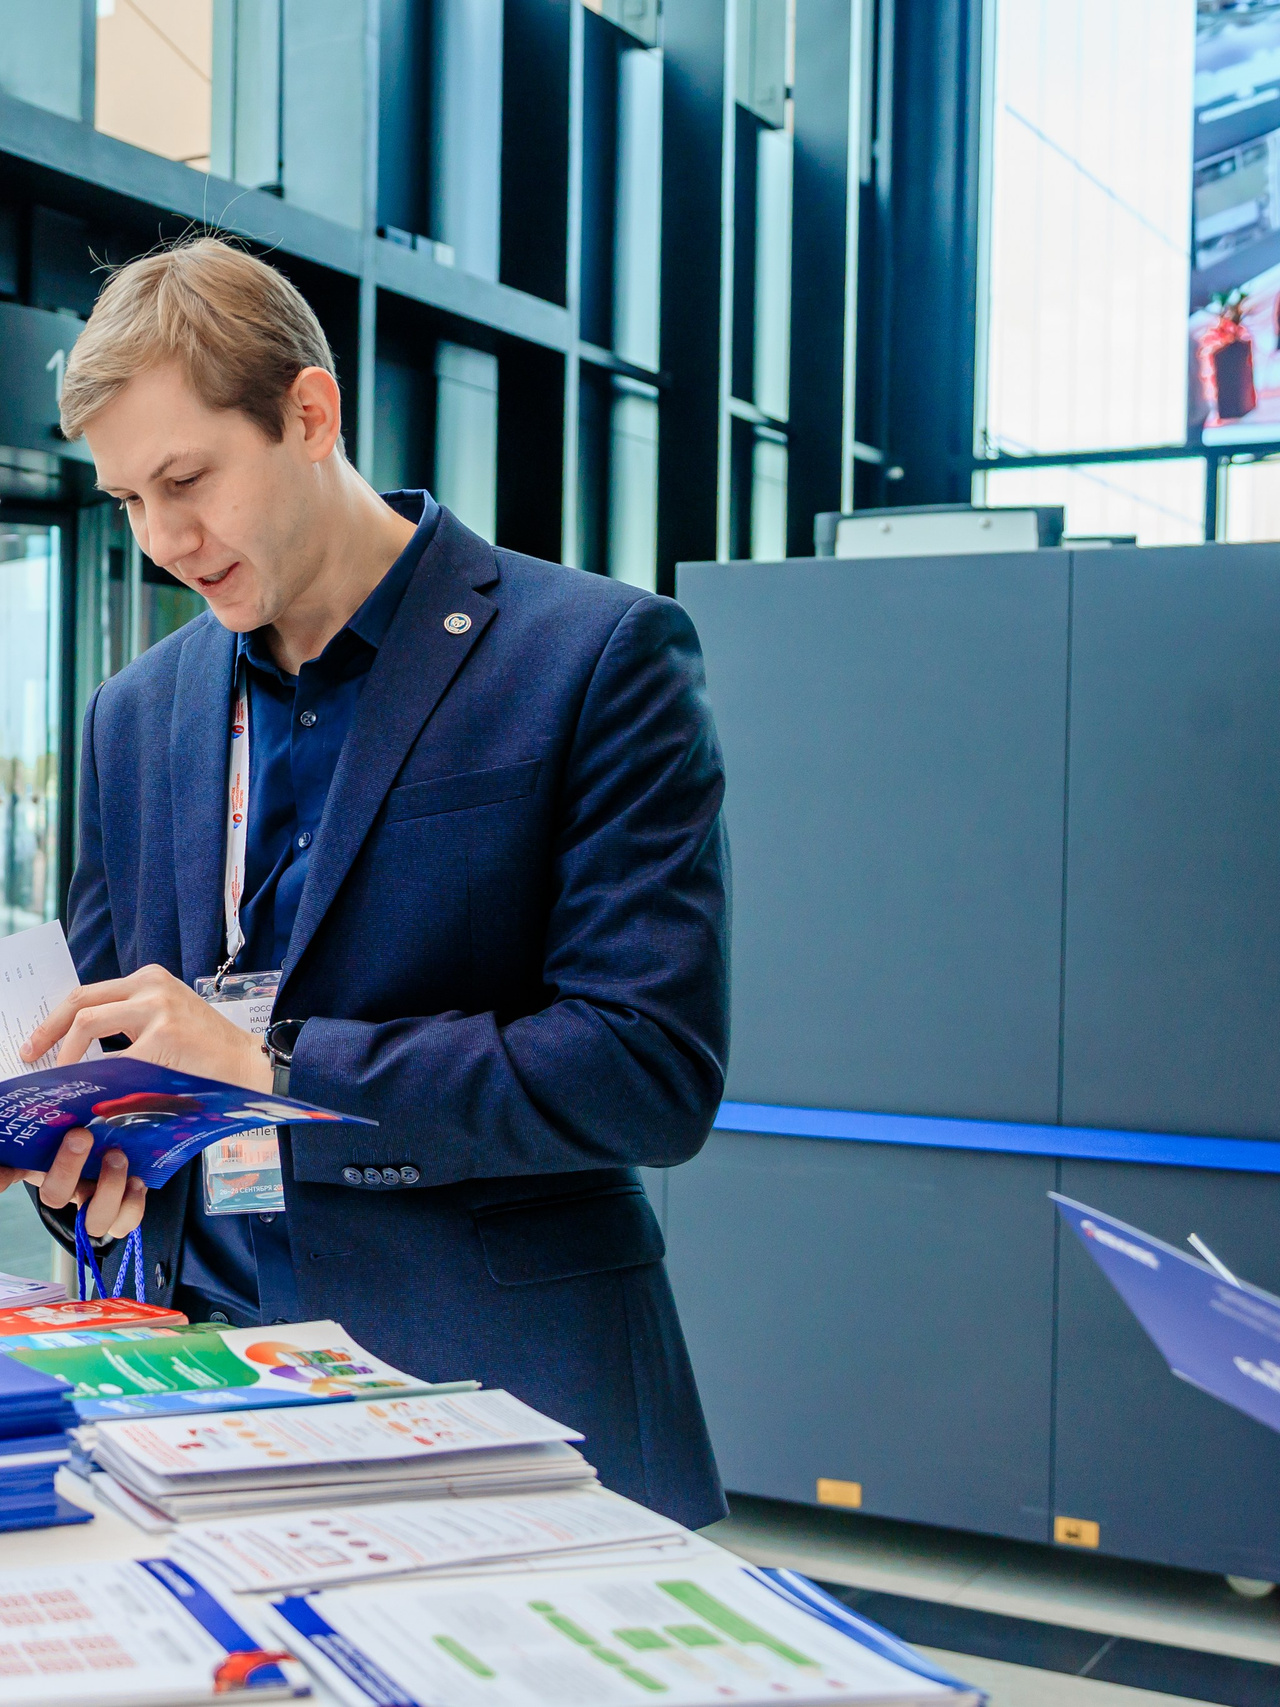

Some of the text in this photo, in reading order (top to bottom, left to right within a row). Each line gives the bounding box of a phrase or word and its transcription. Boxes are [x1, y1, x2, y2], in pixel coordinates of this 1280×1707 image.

[249, 1004, 272, 1013] РОСС
[250, 1015, 270, 1024] НАЦИ
[250, 1026, 267, 1034] КОН
[13, 1108, 67, 1147] ЛЕГКО!
[239, 1184, 273, 1194] СЕНТЯБРЯ
